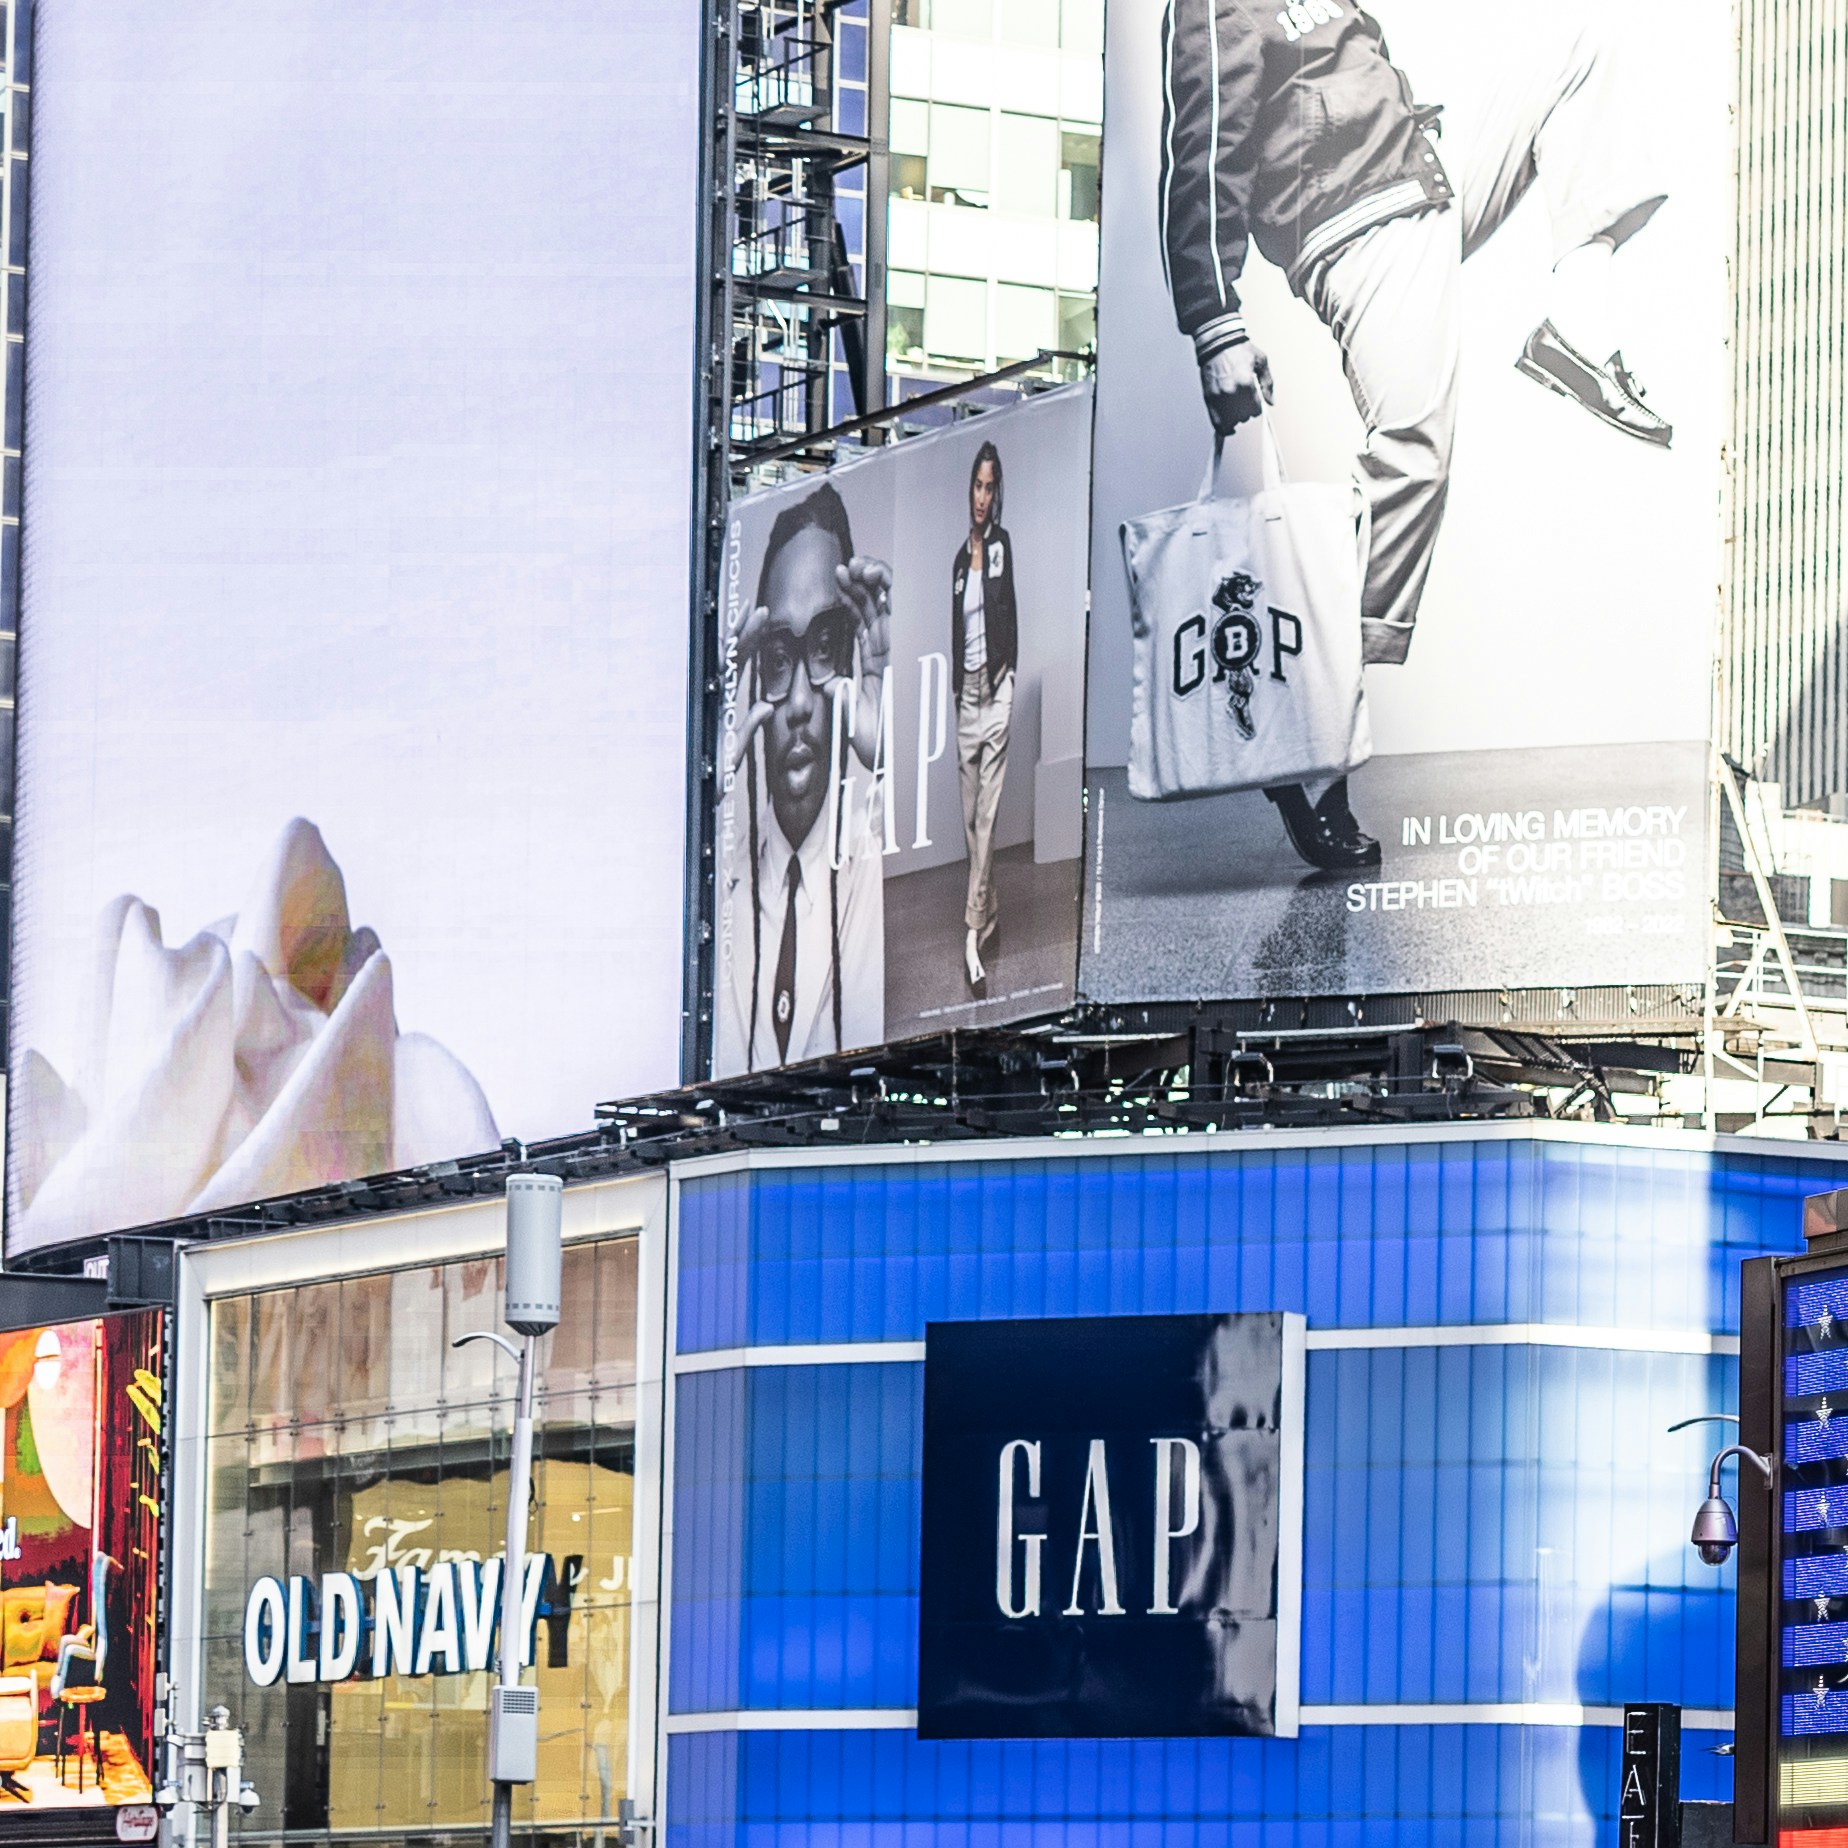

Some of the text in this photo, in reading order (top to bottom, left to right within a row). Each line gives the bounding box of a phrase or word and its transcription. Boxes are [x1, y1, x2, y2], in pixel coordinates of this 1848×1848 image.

[726, 519, 742, 629] CIRCUS
[722, 635, 738, 793] BROOKLYN
[828, 651, 948, 871] GAP
[1402, 806, 1688, 846] IN LOVING MEMORY
[1458, 838, 1686, 876] OF OUR FRIEND
[1346, 878, 1478, 912] STEPHEN
[1601, 871, 1687, 901] BOSS
[995, 1437, 1201, 1618] GAP
[245, 1573, 362, 1687] OLD
